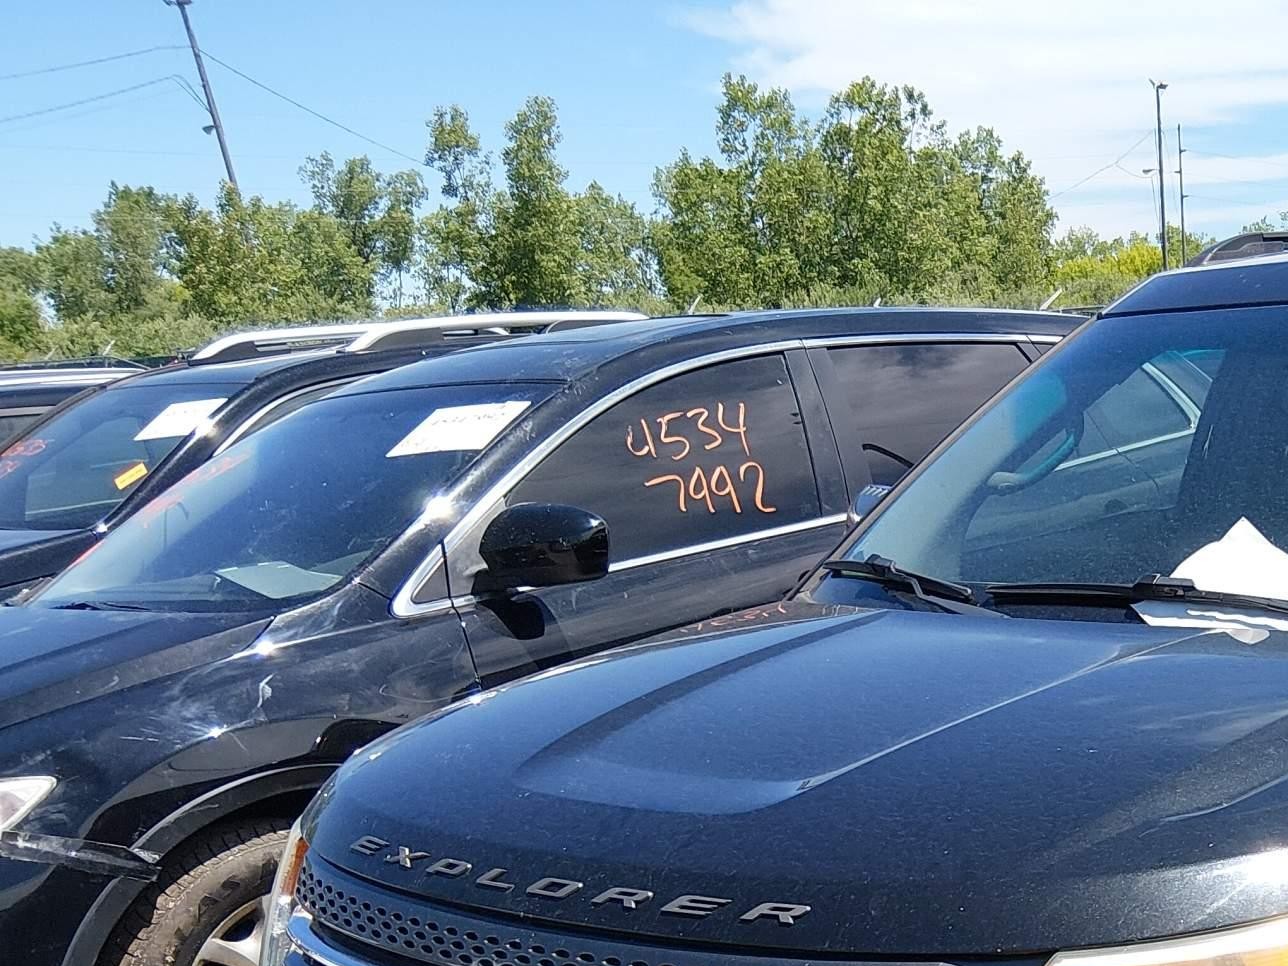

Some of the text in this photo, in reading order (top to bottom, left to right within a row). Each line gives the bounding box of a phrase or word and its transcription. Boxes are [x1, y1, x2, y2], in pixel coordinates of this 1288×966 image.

[627, 402, 749, 460] 4534
[644, 461, 777, 513] 7992
[350, 834, 812, 924] EXPLORER
